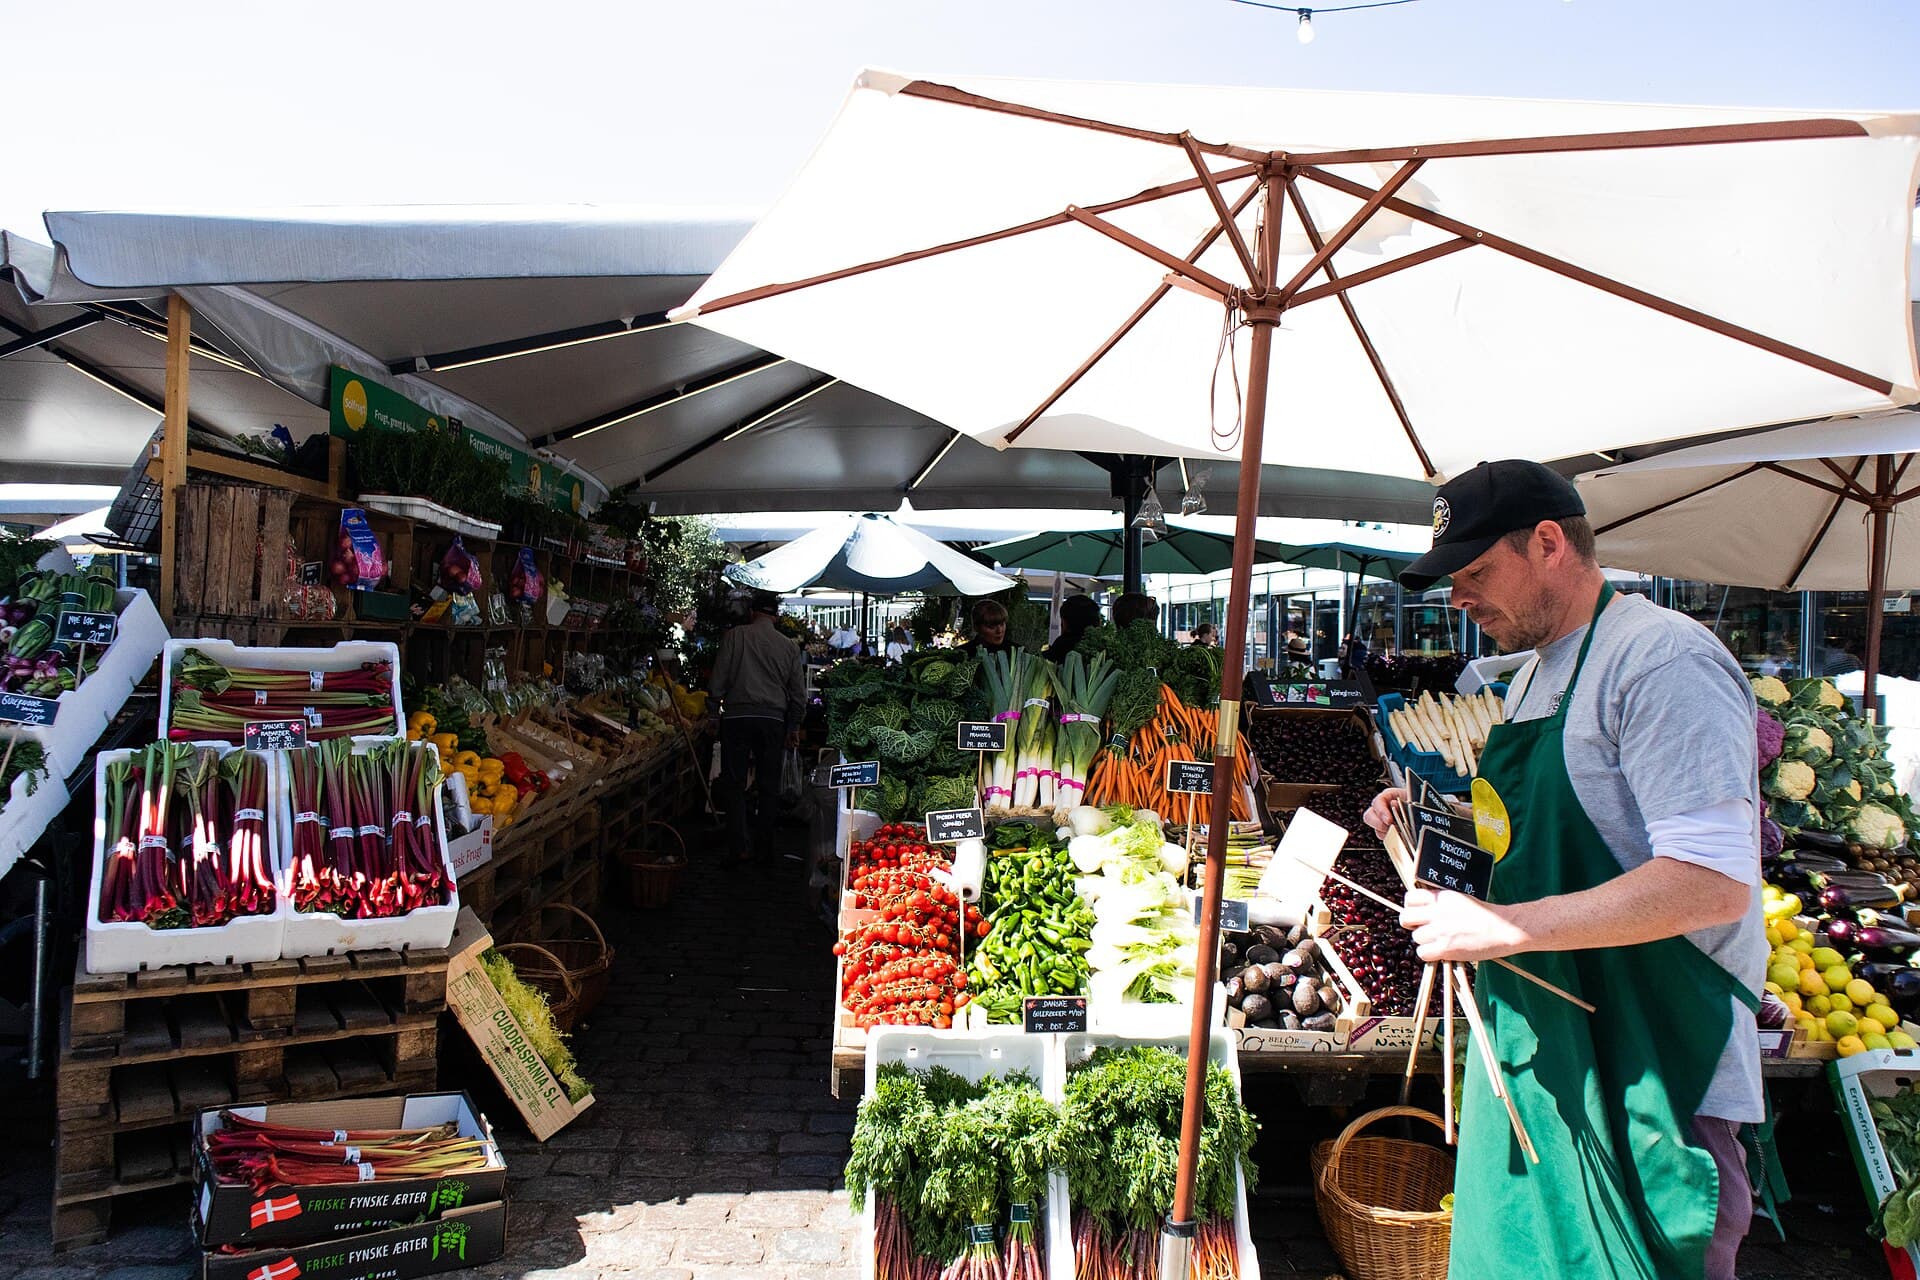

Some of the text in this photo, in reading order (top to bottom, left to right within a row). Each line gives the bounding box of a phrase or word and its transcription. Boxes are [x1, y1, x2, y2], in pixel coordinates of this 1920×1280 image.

[1042, 1000, 1068, 1008] DANSKE
[492, 1009, 550, 1092] CUADRASPANIA,
[1850, 1087, 1875, 1154] Erntefrisch
[1873, 1159, 1884, 1180] aus
[308, 1192, 427, 1212] FRISKE FYNSKE ÆRTER
[334, 1222, 362, 1230] GREEN
[306, 1237, 428, 1272] FRISKE FYNSKE ÆRTER
[376, 1269, 398, 1279] PEAS
